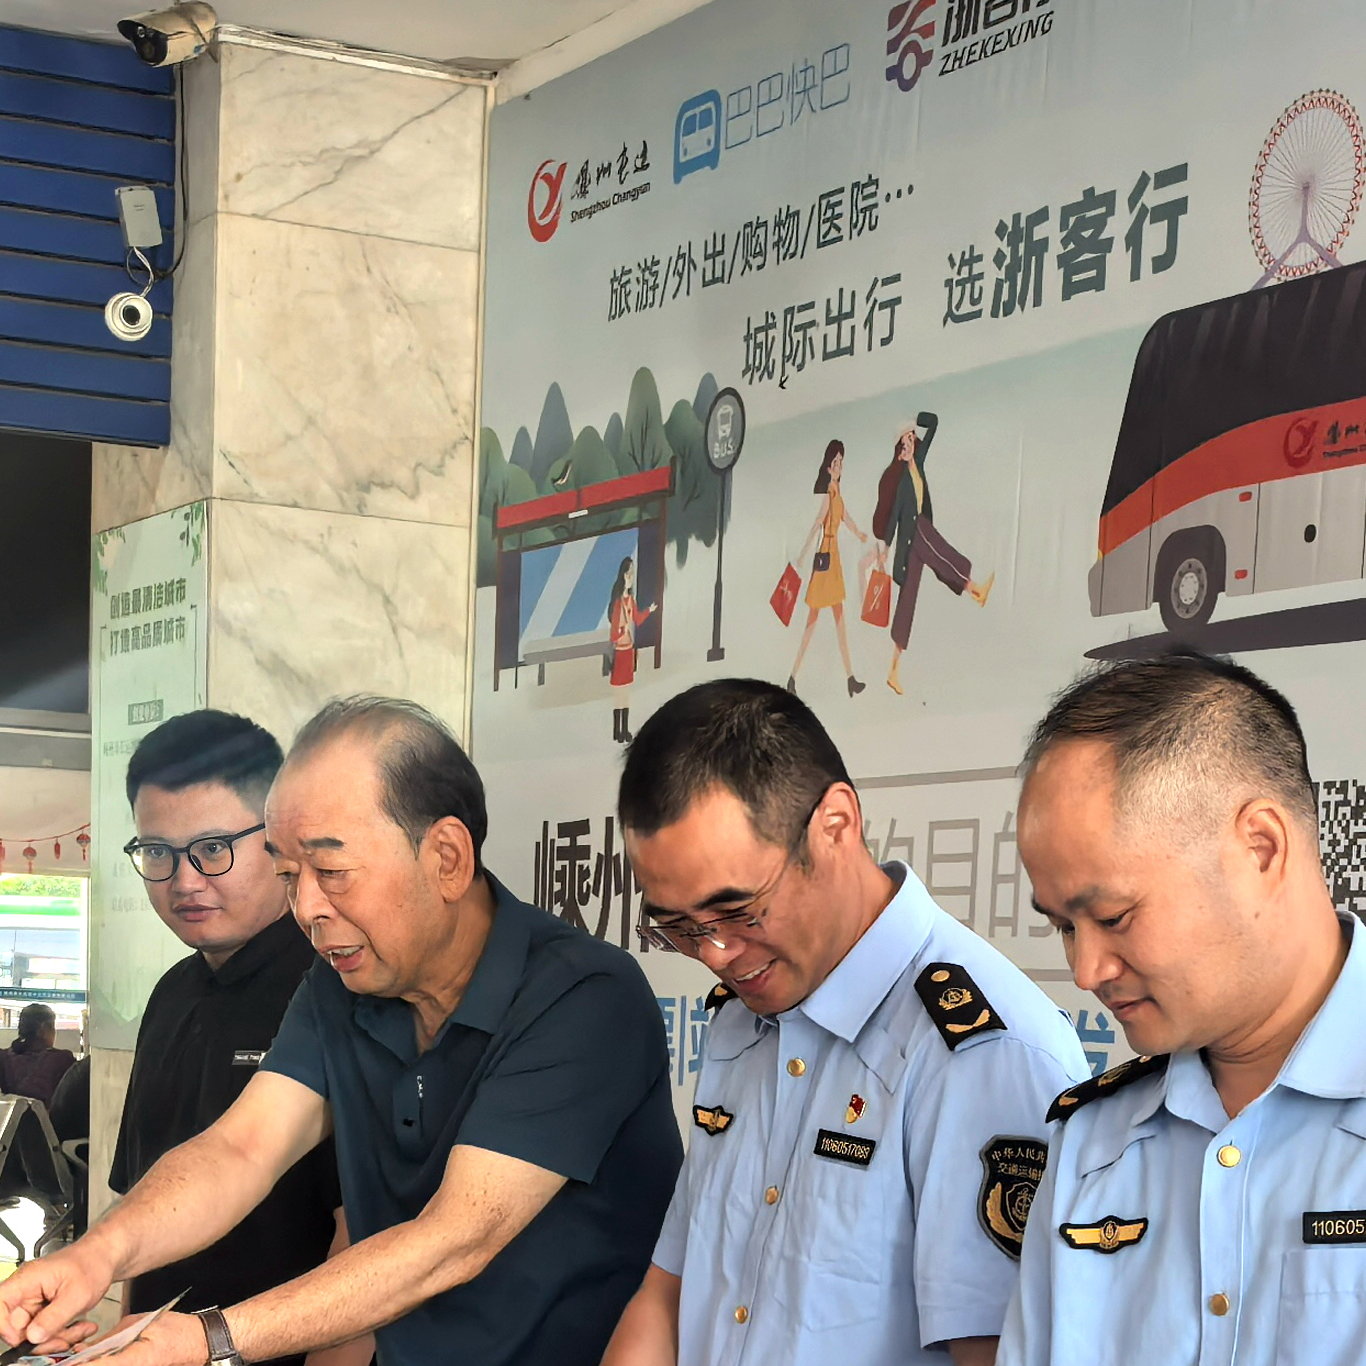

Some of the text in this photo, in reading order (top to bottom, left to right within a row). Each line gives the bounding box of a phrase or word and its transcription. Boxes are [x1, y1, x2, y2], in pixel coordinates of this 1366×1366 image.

[938, 10, 1055, 76] ZHEKEXING
[725, 43, 851, 150] 巴巴快巴
[741, 162, 1189, 386] 城际出行 选浙客行
[713, 438, 734, 459] BUS
